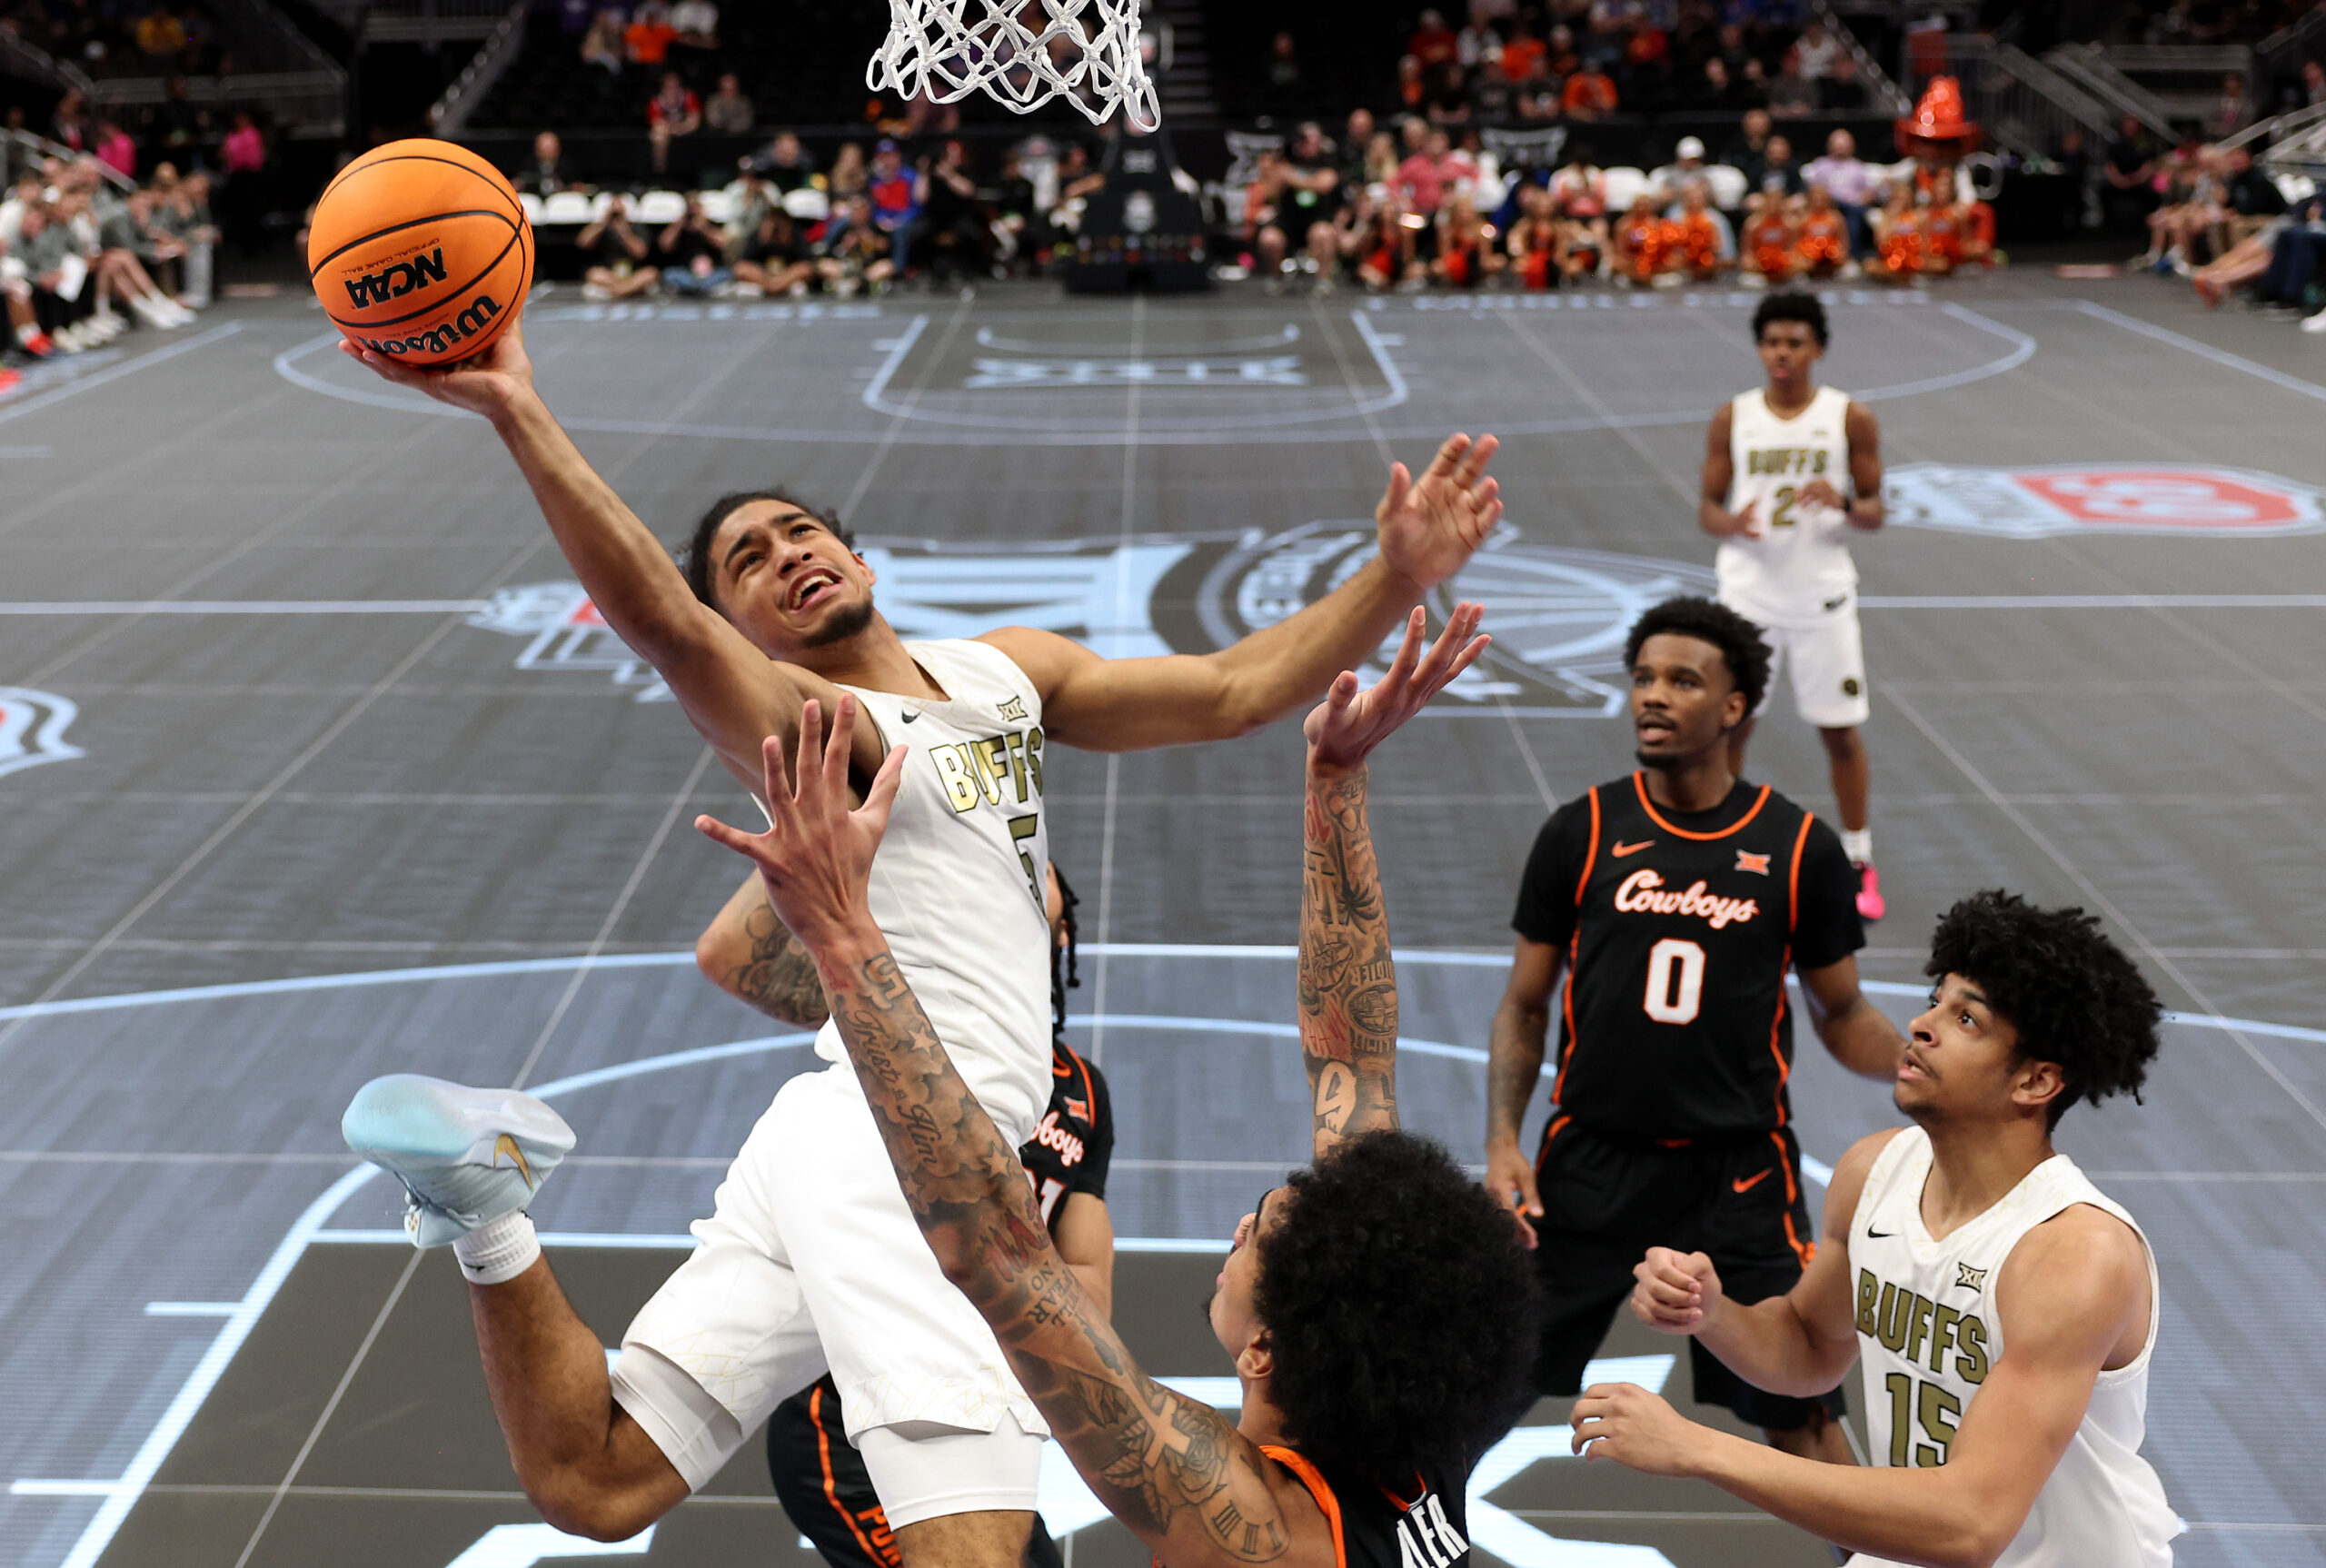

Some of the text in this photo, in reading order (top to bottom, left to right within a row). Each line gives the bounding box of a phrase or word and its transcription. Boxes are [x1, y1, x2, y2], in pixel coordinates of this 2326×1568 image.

[342, 237, 440, 276] OFFICIAL GAME BALL
[344, 246, 447, 310] NCAA
[355, 294, 502, 355] Wilson
[1748, 449, 1828, 474] BUFFS
[1772, 486, 1796, 526] 2
[929, 727, 1043, 813] BUFFS
[1615, 868, 1761, 929] Cowboys
[1644, 937, 1706, 1026] 0
[1856, 1267, 1988, 1384] BUFFS
[1885, 1373, 1962, 1468] 15
